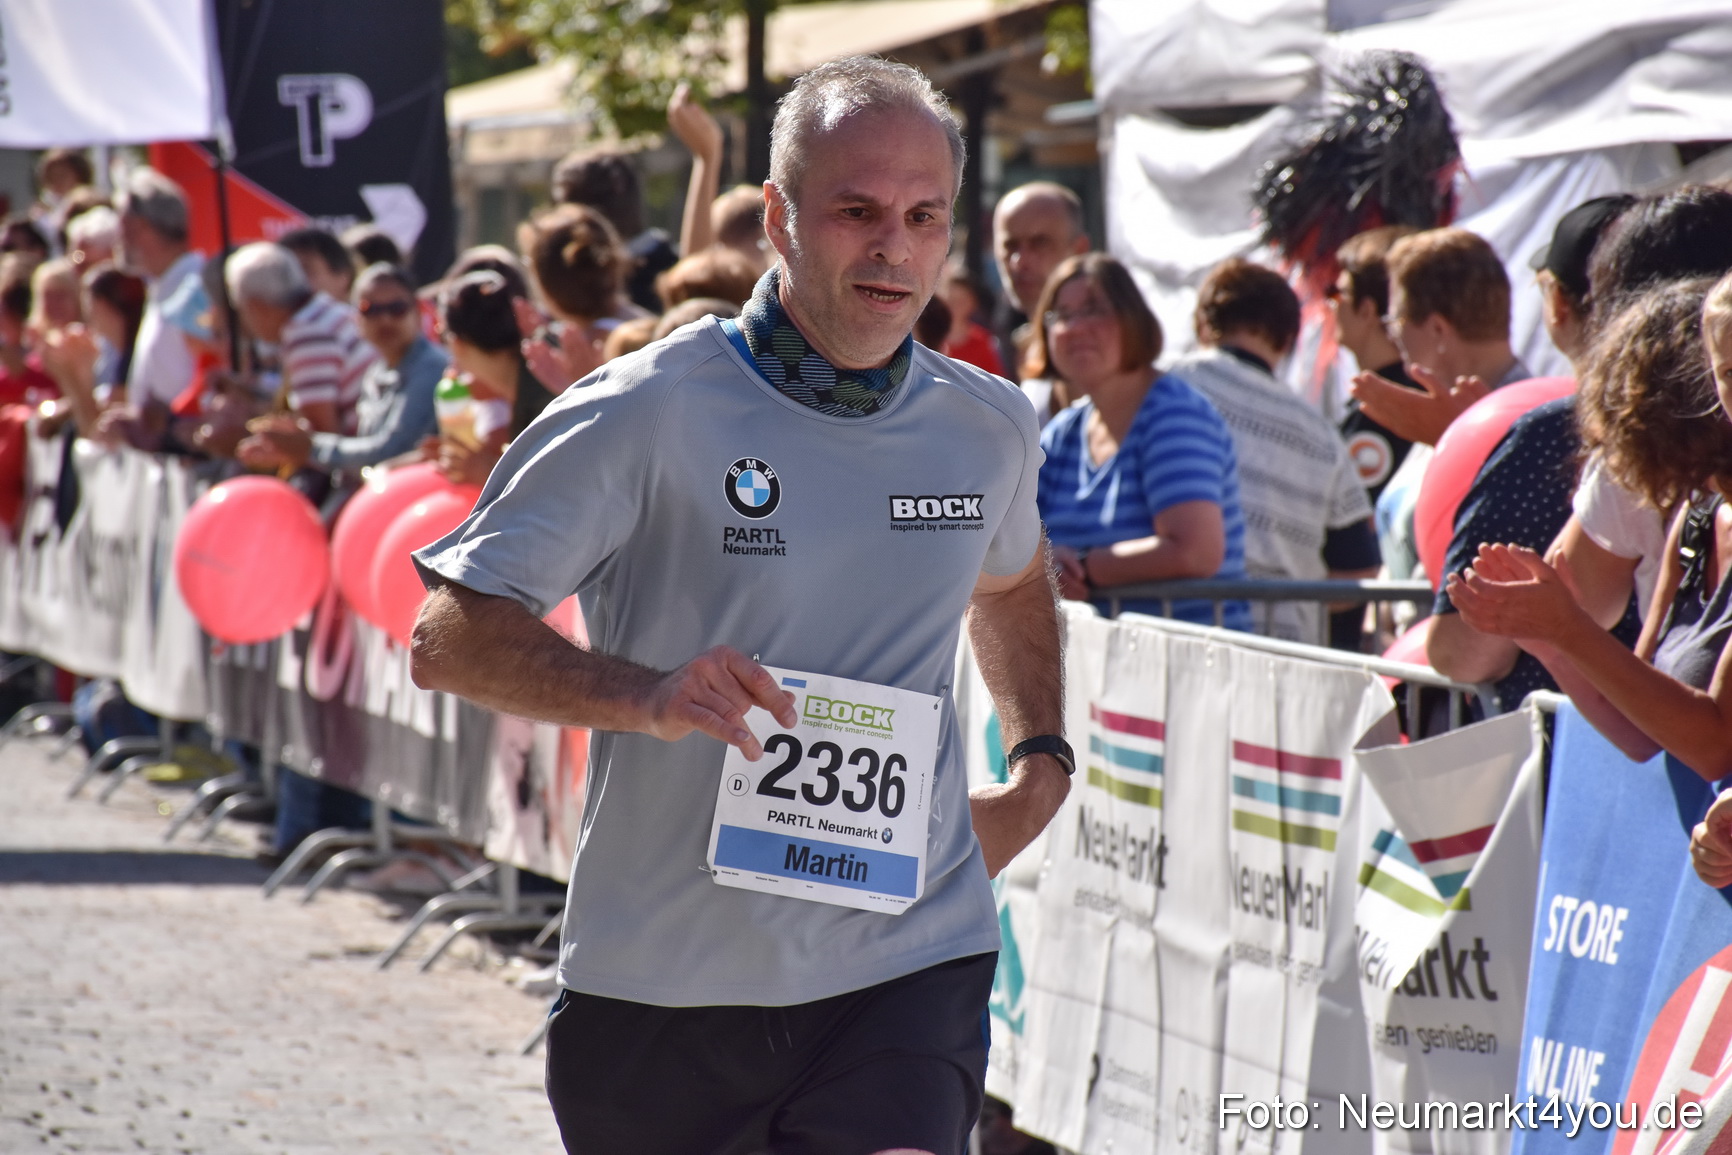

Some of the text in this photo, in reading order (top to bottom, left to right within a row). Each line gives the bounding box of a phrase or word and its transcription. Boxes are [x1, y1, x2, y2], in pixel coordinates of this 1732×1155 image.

[730, 459, 775, 480] BMW
[890, 496, 984, 521] BOCK
[724, 527, 786, 544] PARTL
[890, 523, 984, 532] inspired by smart concepts
[723, 542, 786, 557] Neumarkt
[804, 695, 896, 731] BOCK
[802, 718, 894, 741] inspired by smart concepts
[756, 733, 908, 819] 2336
[767, 810, 878, 840] PARTL Neumarkt
[784, 843, 869, 883] Martin
[1543, 894, 1629, 965] STORE
[1416, 1023, 1497, 1055] genießen
